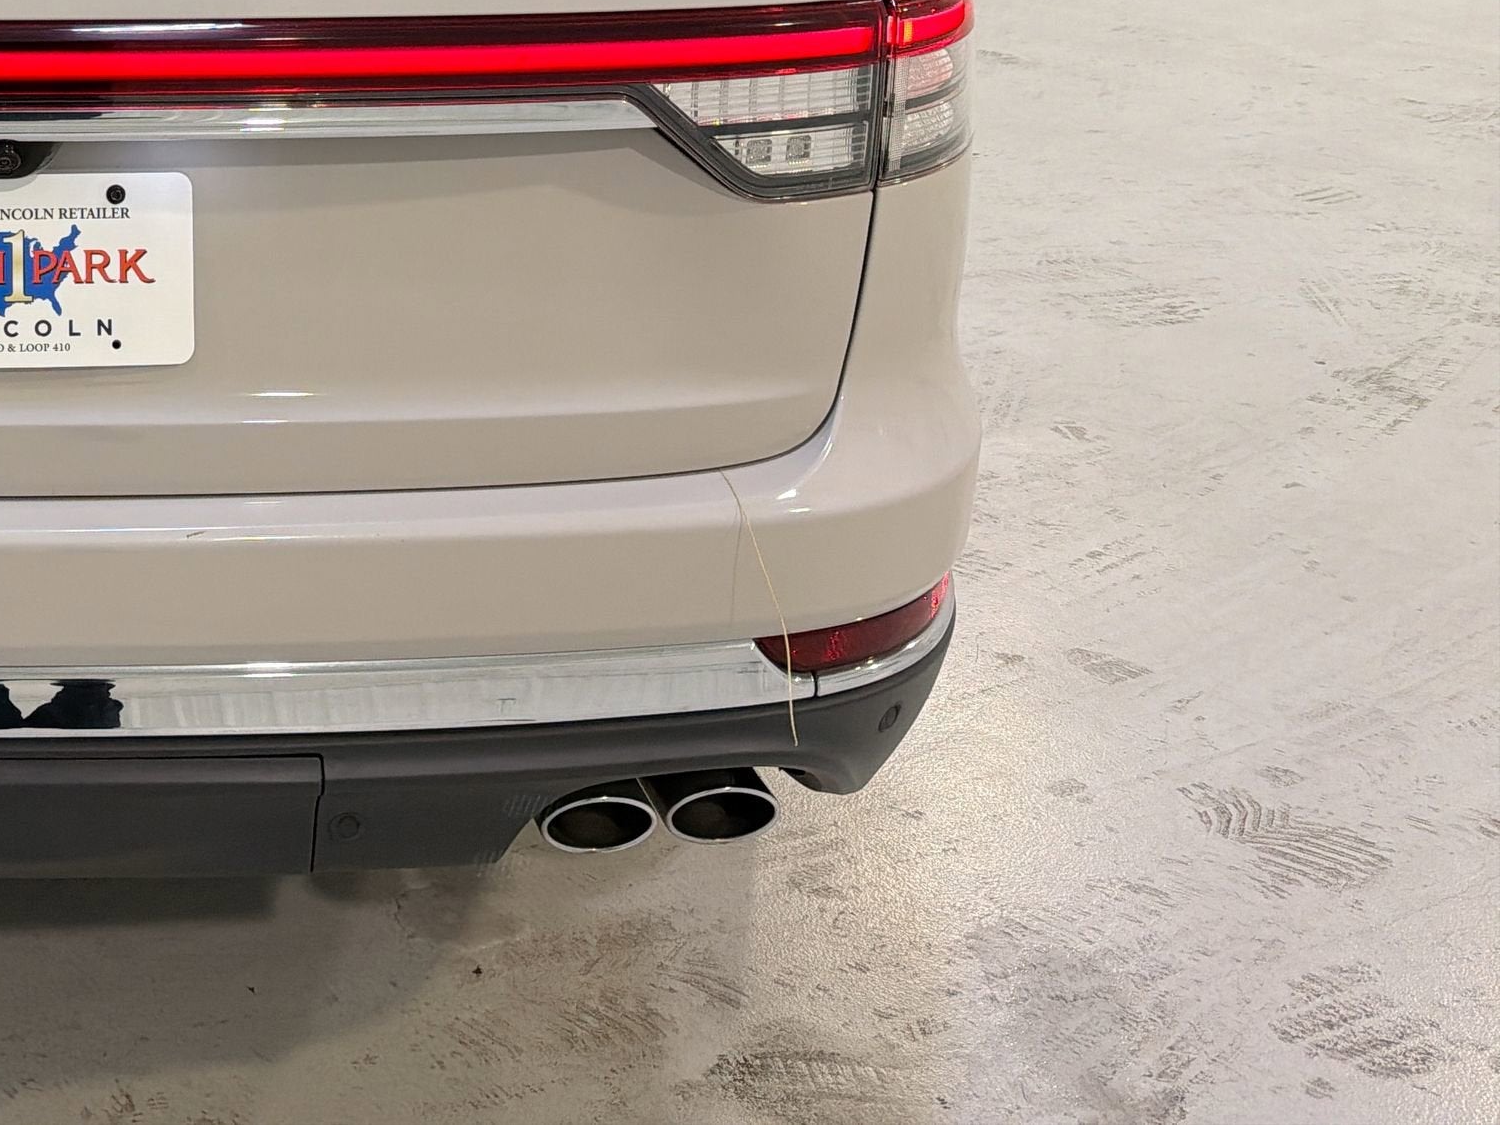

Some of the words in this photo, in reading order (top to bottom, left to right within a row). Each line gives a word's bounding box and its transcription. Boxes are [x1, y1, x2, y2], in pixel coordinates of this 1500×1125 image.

[58, 207, 131, 220] RETAILER
[31, 248, 157, 285] PARK
[7, 344, 16, 353] &
[19, 342, 50, 353] LOOP
[52, 342, 71, 352] 410
